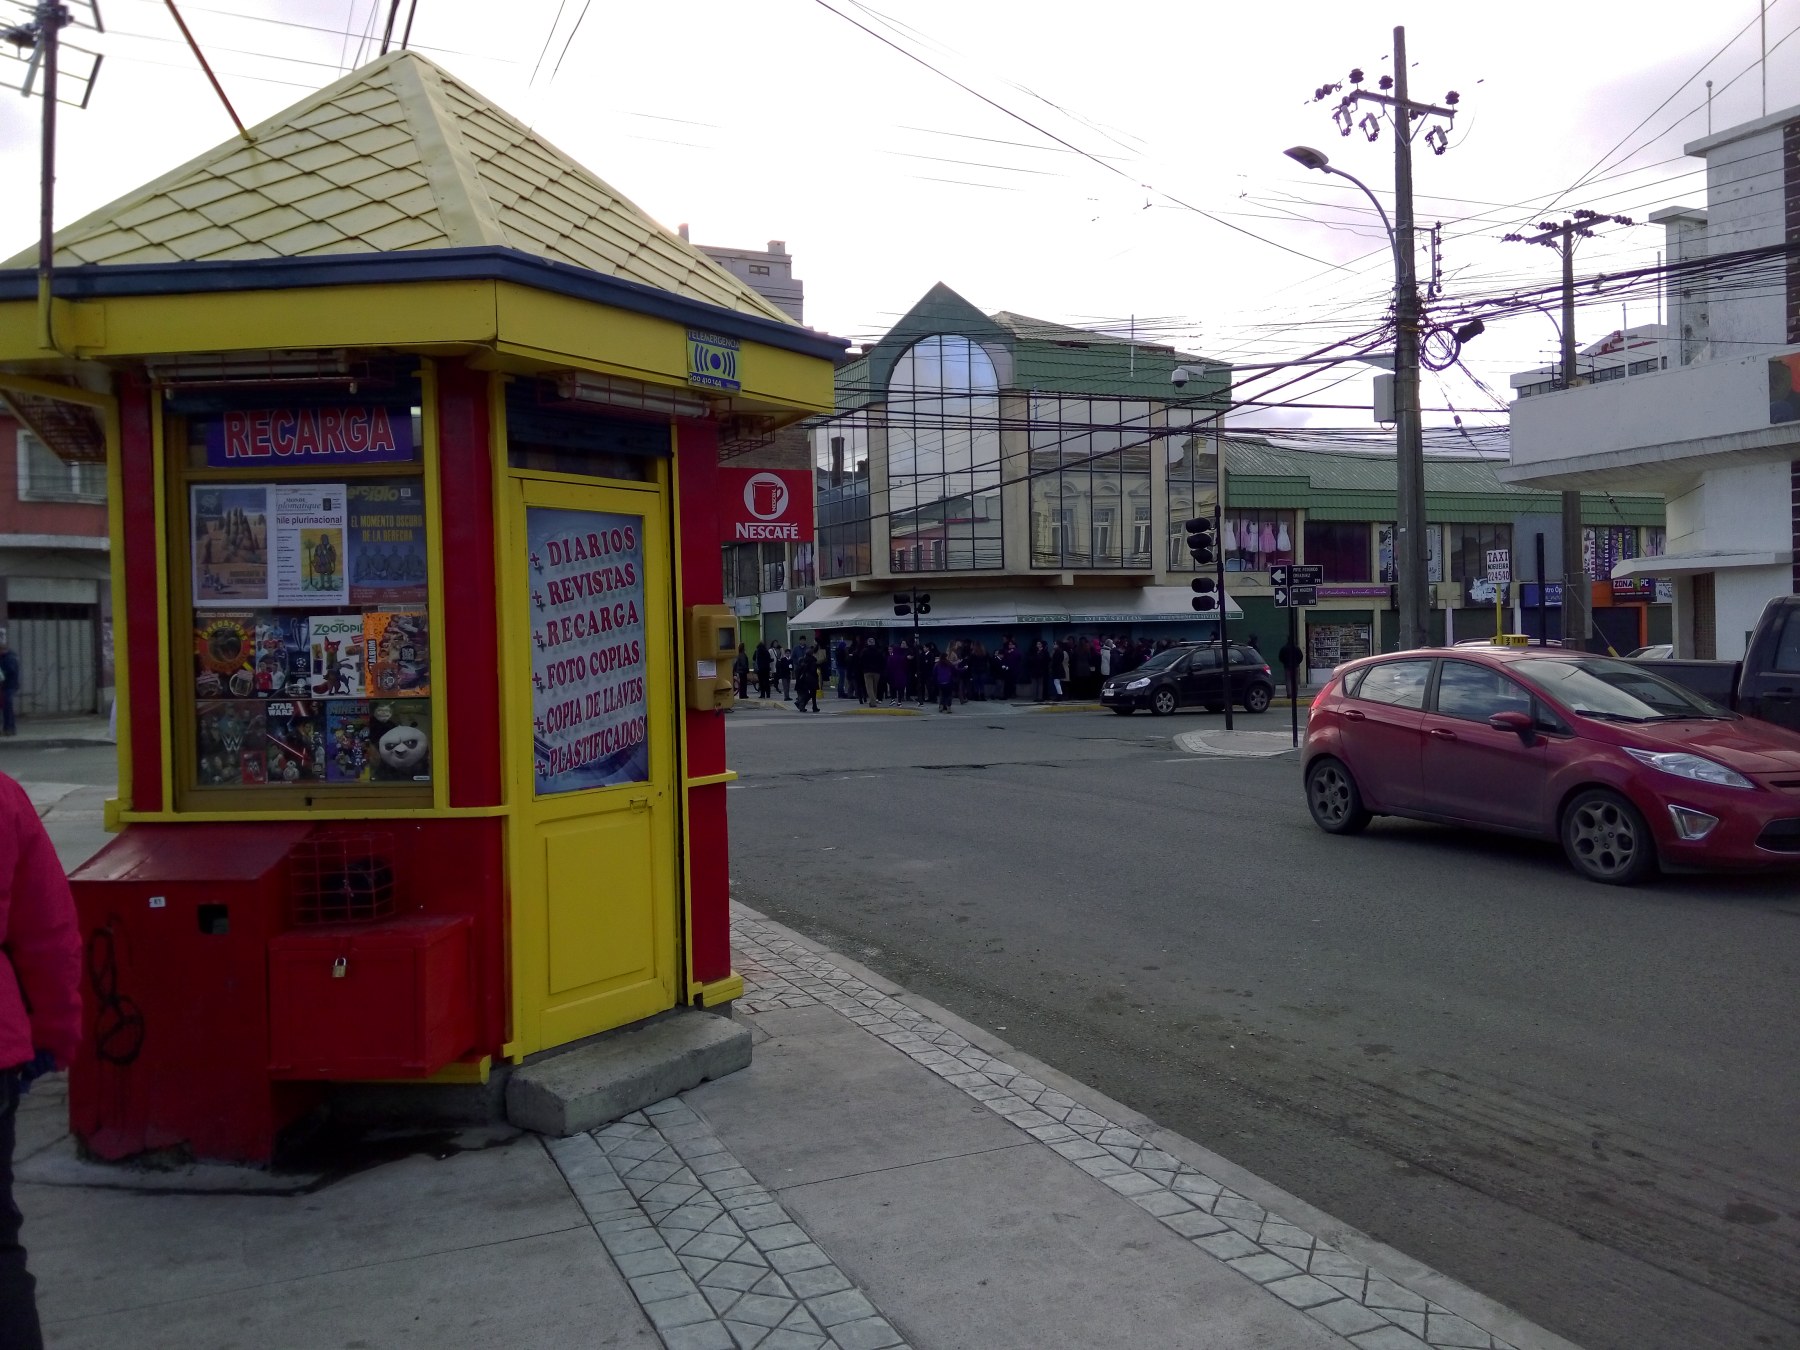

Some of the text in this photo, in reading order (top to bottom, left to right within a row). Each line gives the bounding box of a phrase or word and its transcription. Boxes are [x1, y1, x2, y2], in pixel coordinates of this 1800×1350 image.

[702, 377, 713, 385] 410
[223, 405, 396, 458] RECARGA
[276, 516, 342, 525] hile plurinacional
[360, 514, 394, 528] MOMENTO
[736, 522, 799, 539] NESCAFÉ
[546, 526, 636, 567] DIARIOS
[1488, 551, 1508, 562] TAXI
[547, 562, 637, 606] REVISTAS
[1488, 570, 1510, 581] 224540
[1614, 580, 1633, 588] ZONA
[1640, 579, 1649, 587] PC
[546, 599, 640, 648] RECARGA
[368, 640, 377, 663] ALBUM
[546, 640, 641, 690] FOTO COPIAS
[268, 702, 294, 710] STAR
[546, 676, 643, 735] COPIA DE LLAVES
[548, 716, 645, 778] PLASTIFICADOS
